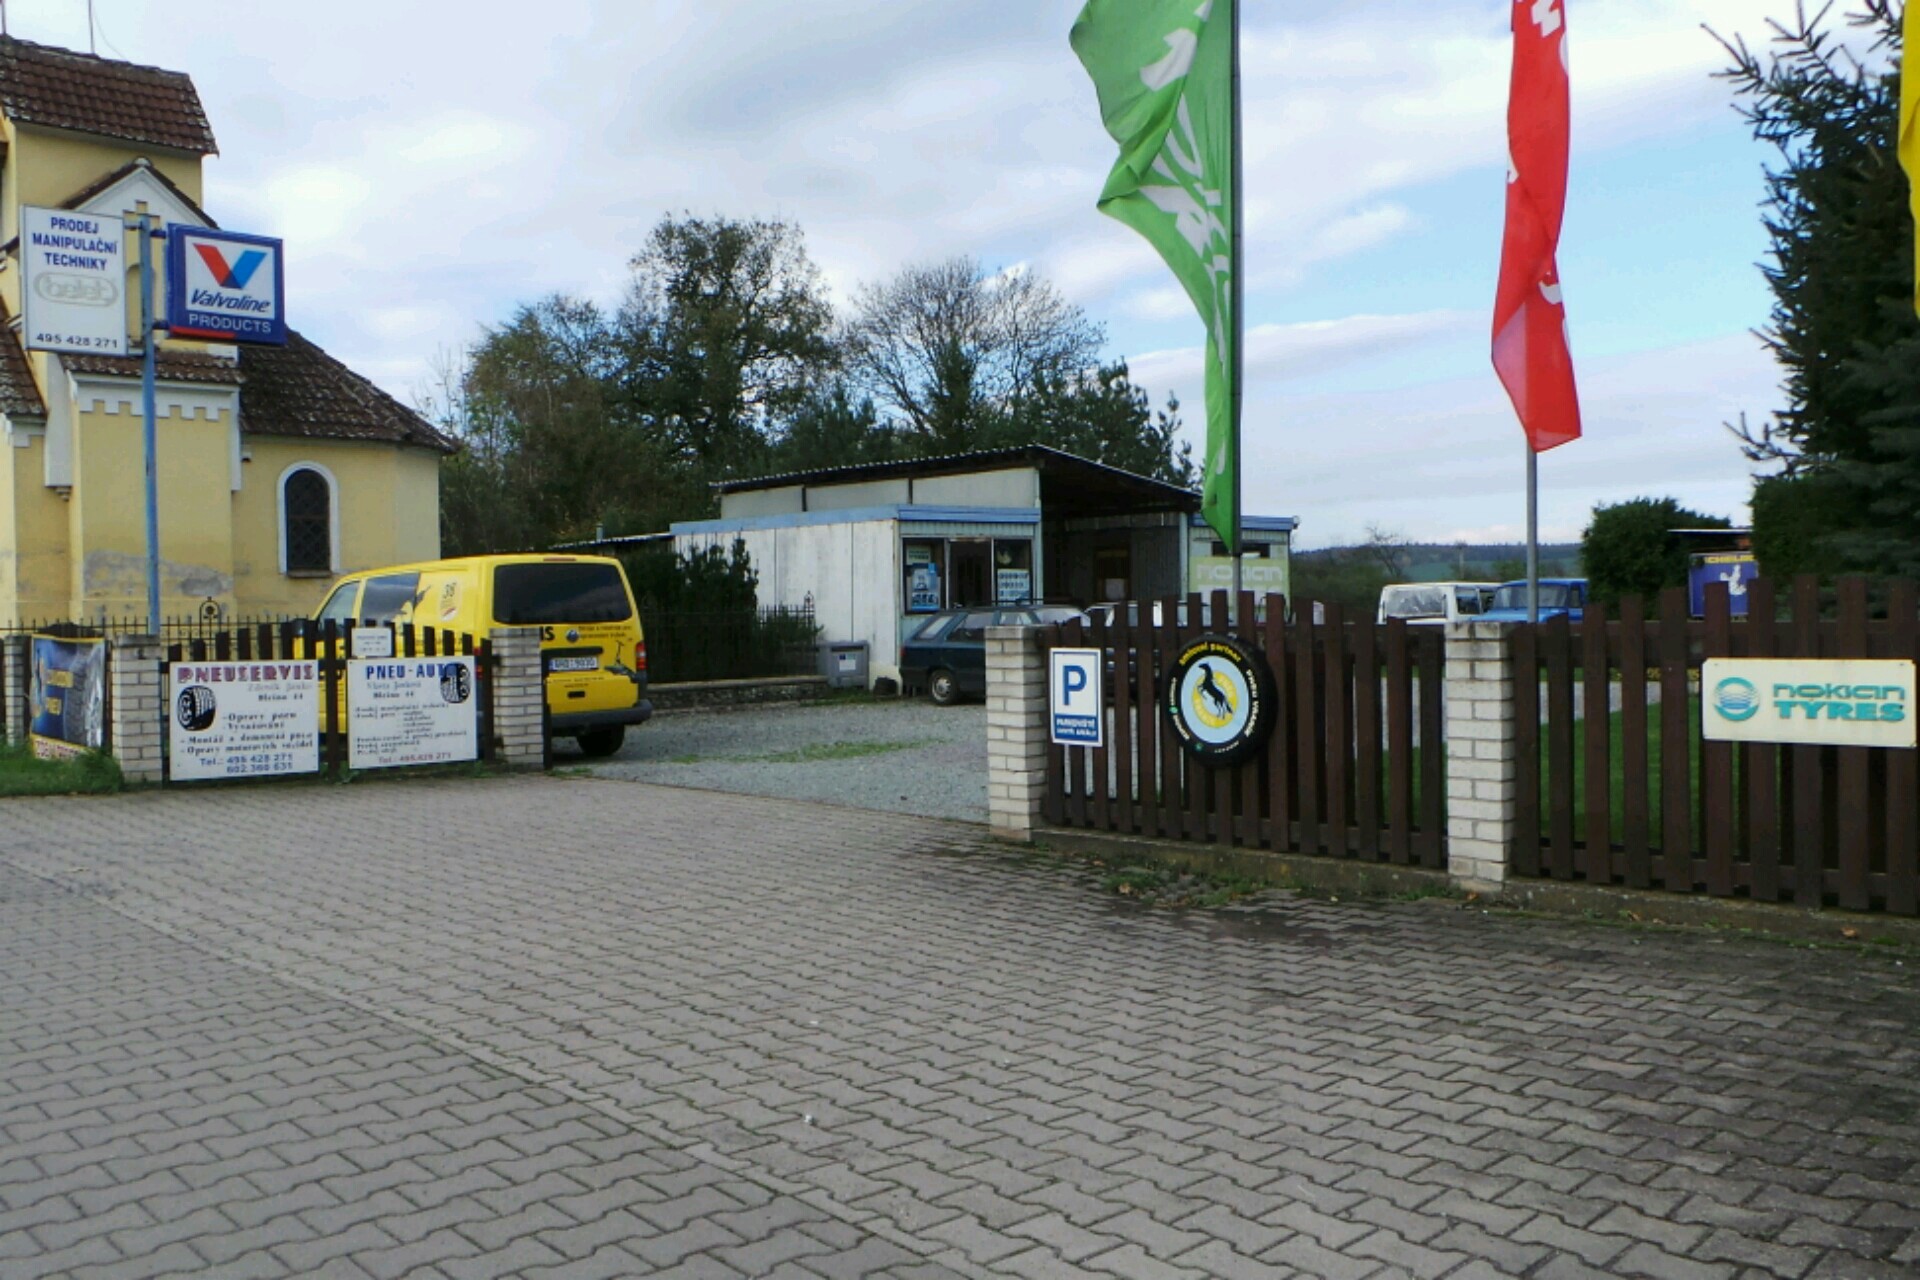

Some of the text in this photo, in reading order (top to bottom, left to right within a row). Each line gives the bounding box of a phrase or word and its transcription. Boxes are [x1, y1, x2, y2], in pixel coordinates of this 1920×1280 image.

[50, 217, 99, 234] PRODEJ
[32, 233, 118, 255] MANIPULAČNÍ
[45, 252, 107, 271] TECHNIKY
[191, 288, 271, 313] Valvoline
[189, 313, 271, 333] PRODUCTS
[36, 333, 118, 348] 495 428 271
[177, 664, 314, 683] PNEUSERVIS
[1063, 664, 1087, 705] P
[1774, 701, 1905, 722] TYRES
